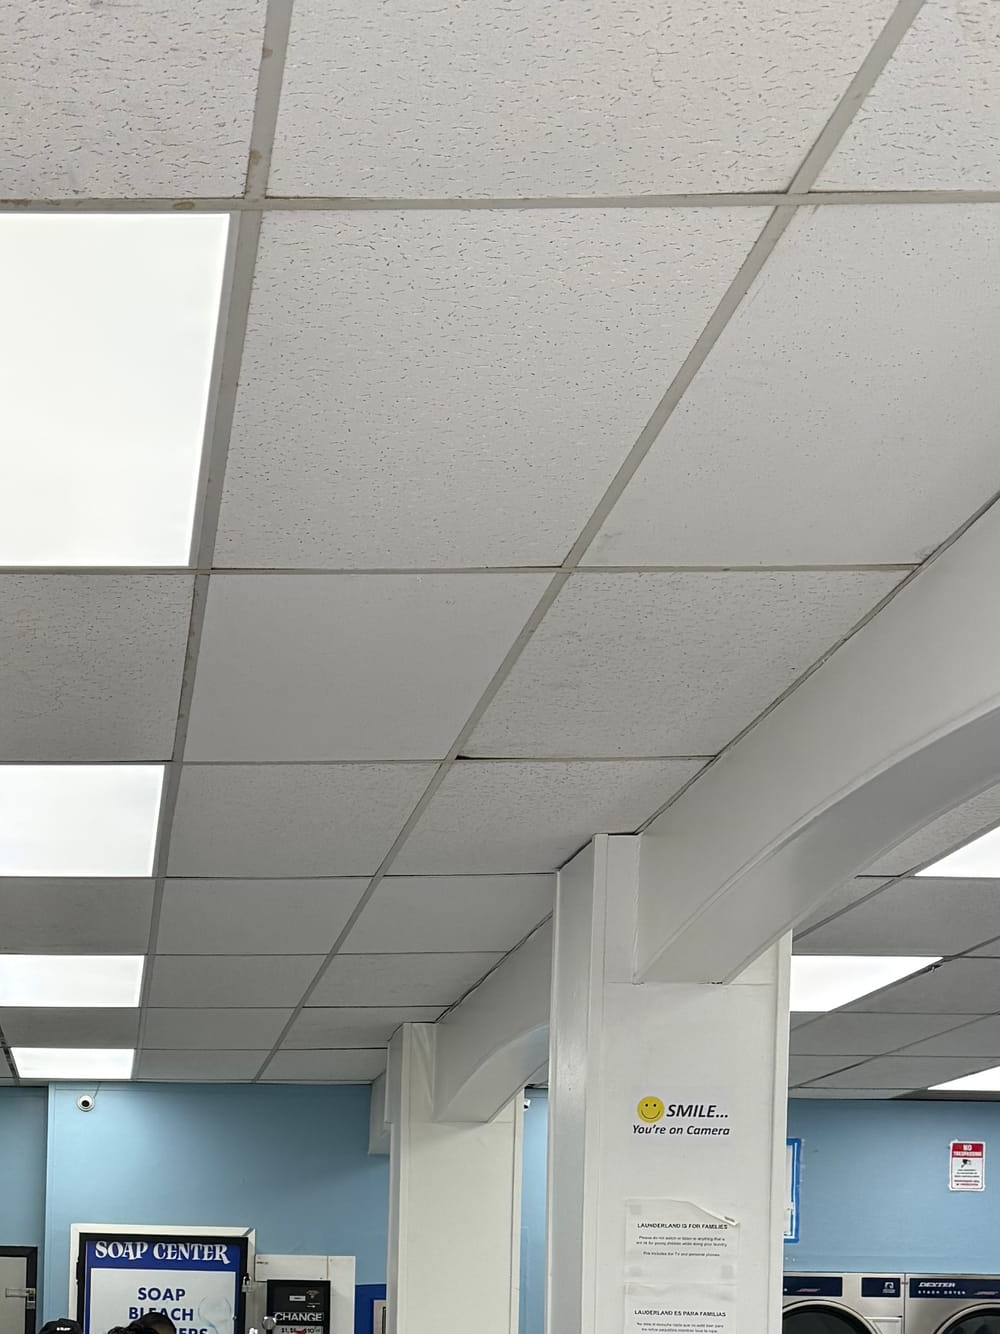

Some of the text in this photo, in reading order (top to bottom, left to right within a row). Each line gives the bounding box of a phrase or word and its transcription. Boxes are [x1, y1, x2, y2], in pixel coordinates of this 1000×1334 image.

[666, 1104, 728, 1118] SMILE...
[633, 1124, 730, 1136] You're on Camera
[95, 1240, 230, 1264] SOAP CENTER
[138, 1287, 186, 1301] SOAP
[274, 1312, 322, 1322] CHANGE
